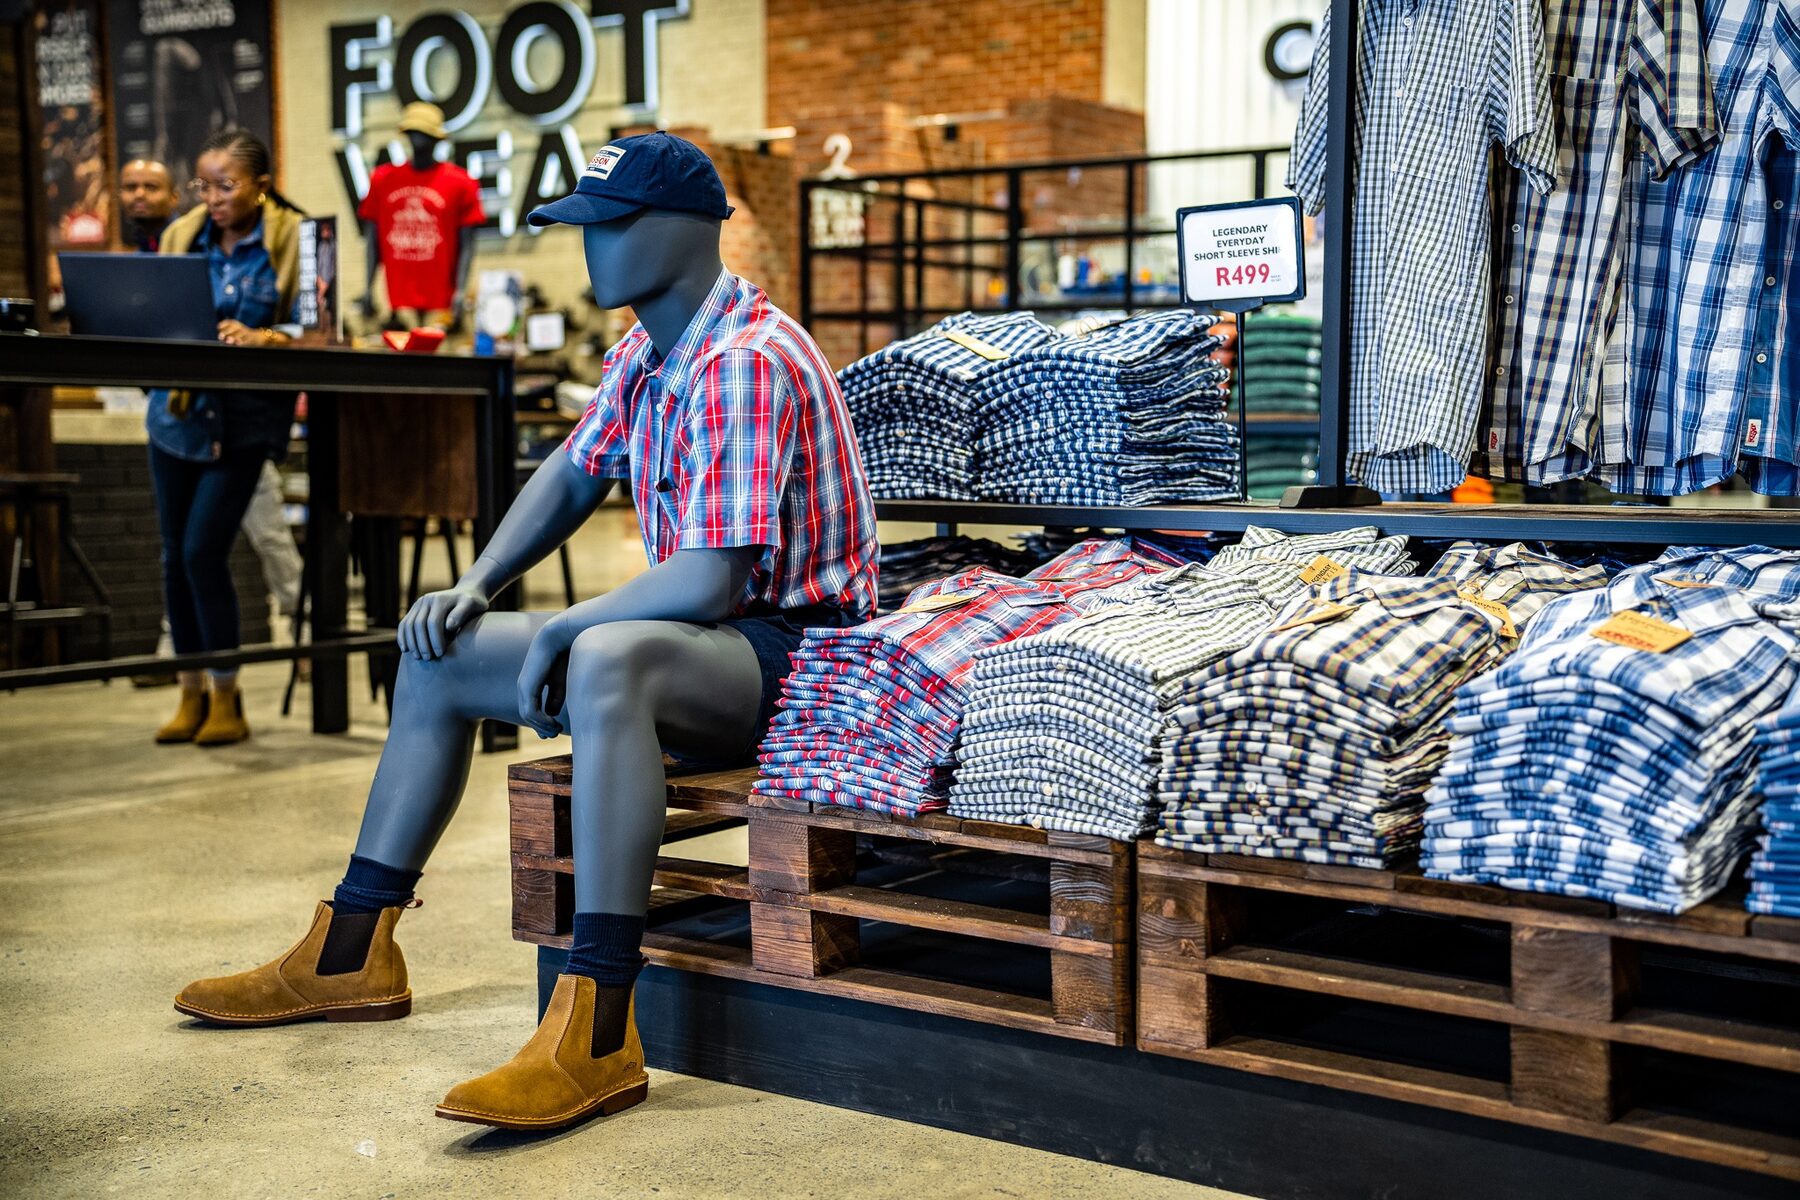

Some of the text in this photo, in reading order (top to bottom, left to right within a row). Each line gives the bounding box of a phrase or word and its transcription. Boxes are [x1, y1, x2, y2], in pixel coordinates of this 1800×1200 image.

[330, 0, 686, 134] FOOT
[1212, 224, 1268, 237] LEGENDARY
[1216, 236, 1265, 248] EVERYDAY
[1194, 246, 1280, 261] SHORT SLEEVE SHI
[1216, 263, 1270, 286] R499
